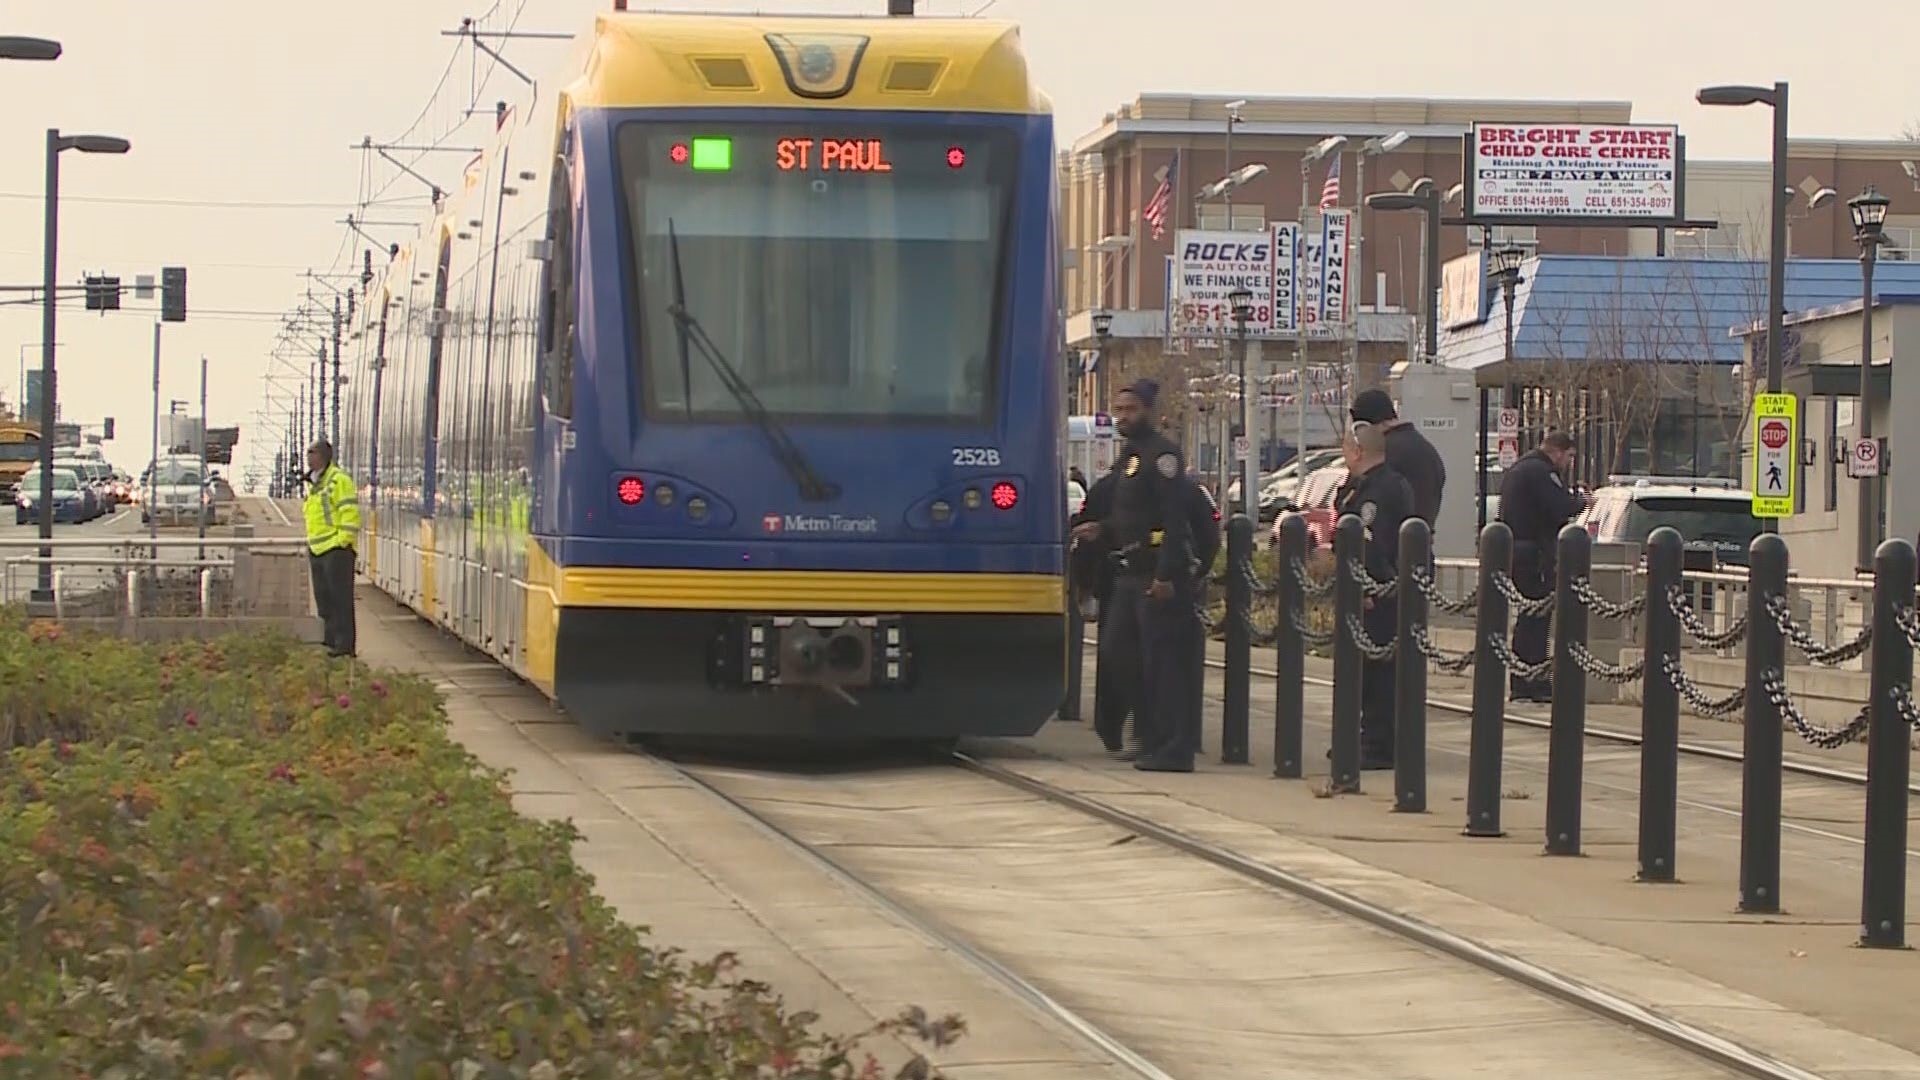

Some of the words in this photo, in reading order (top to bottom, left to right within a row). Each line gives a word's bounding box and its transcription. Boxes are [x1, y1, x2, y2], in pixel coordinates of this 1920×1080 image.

[1589, 130, 1672, 145] START
[777, 139, 813, 170] ST
[822, 139, 893, 171] PAUL
[1480, 145, 1536, 157] CHILD
[1542, 146, 1592, 158] CARE
[1598, 147, 1671, 160] CENTER
[1493, 159, 1542, 168] Raising
[1546, 160, 1555, 168] A
[1559, 160, 1613, 169] Brighter
[1482, 170, 1531, 179] OPEN
[1536, 171, 1546, 179] 7
[1551, 171, 1595, 180] DAYS
[1600, 171, 1613, 180] A
[1617, 171, 1668, 180] WEEK
[1479, 194, 1508, 206] OFFICE
[1513, 195, 1569, 206] 651-414-9956
[1586, 196, 1607, 207] CELL
[1611, 197, 1672, 208] 651-354-8097
[1329, 215, 1345, 226] WE
[1278, 227, 1290, 257] ALL
[1184, 275, 1203, 286] WE
[1207, 275, 1261, 287] FINANCE
[1326, 230, 1343, 321] FINANCE
[1191, 291, 1218, 299] YOUR
[1277, 267, 1290, 329] MODELS
[1762, 397, 1788, 405] STATE
[1766, 406, 1784, 414] LAW
[1762, 430, 1787, 440] STOP
[952, 448, 1001, 466] 252B
